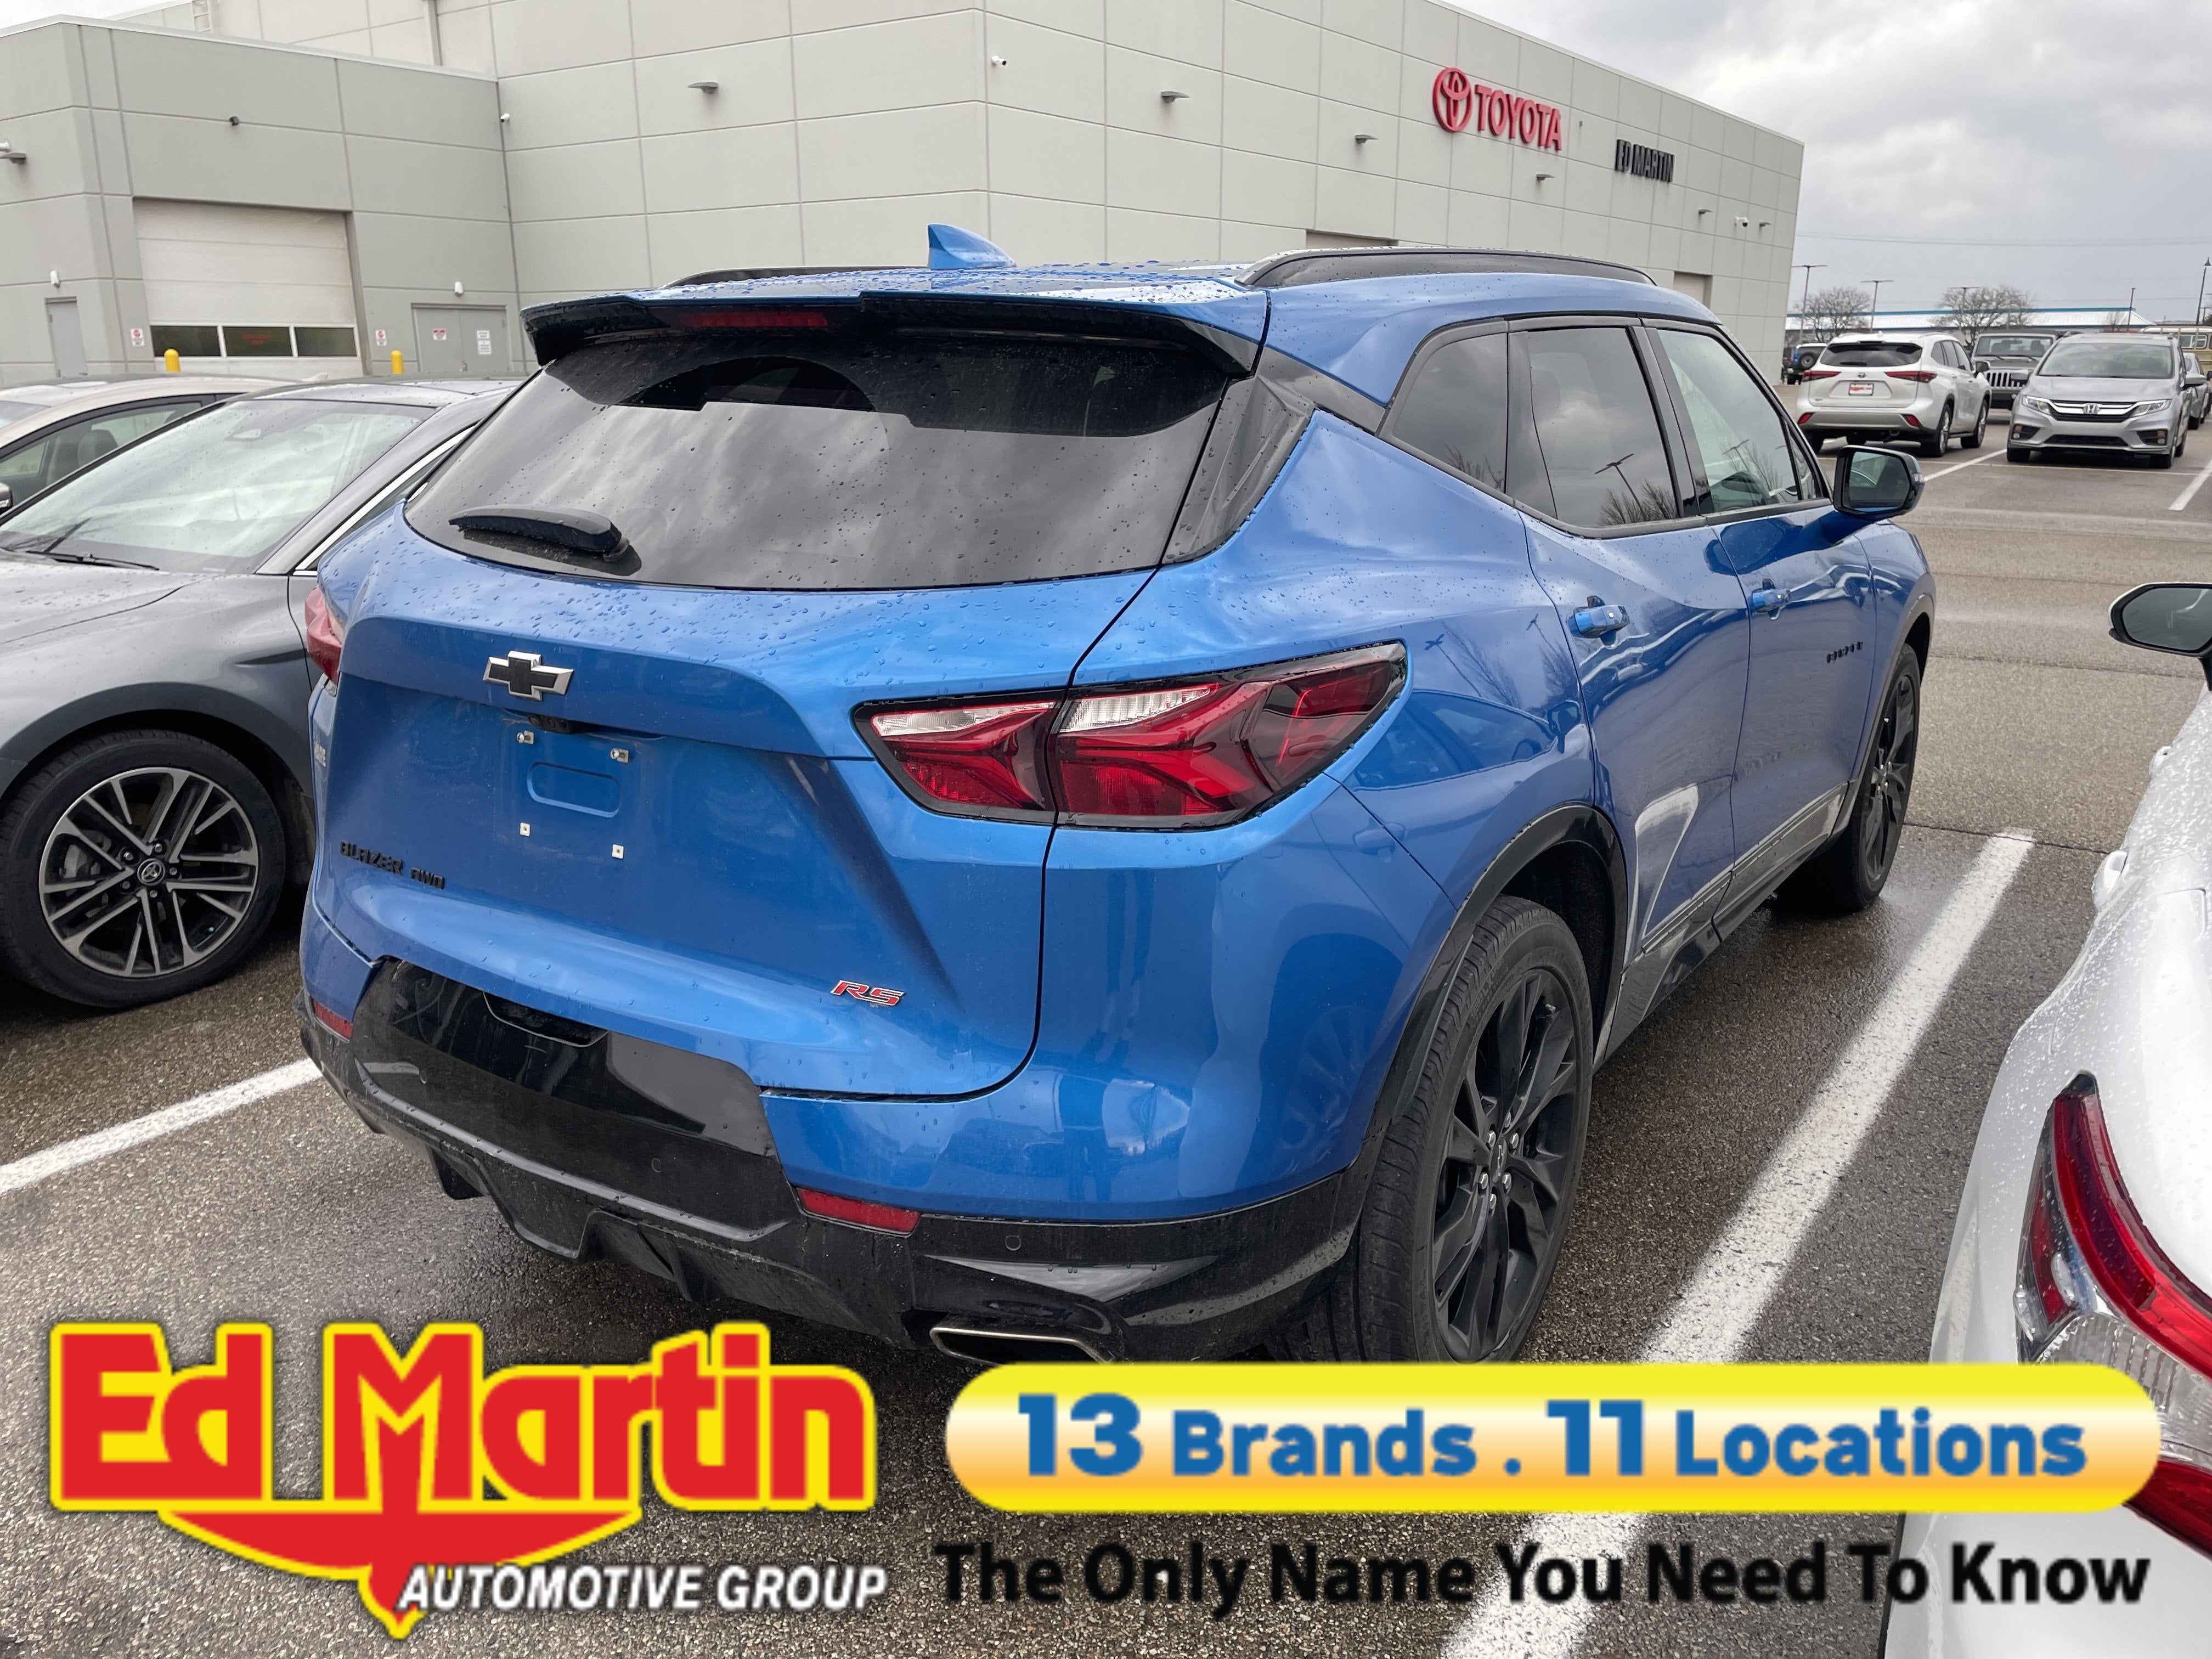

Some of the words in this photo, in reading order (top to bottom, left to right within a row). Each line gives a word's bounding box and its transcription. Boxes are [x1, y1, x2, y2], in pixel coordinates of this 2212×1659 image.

[1475, 84, 1562, 151] TOYOTA
[1615, 139, 1632, 172] ED
[1631, 144, 1675, 183] MARTIN
[340, 840, 404, 876] BLAZER
[830, 980, 905, 1006] RS
